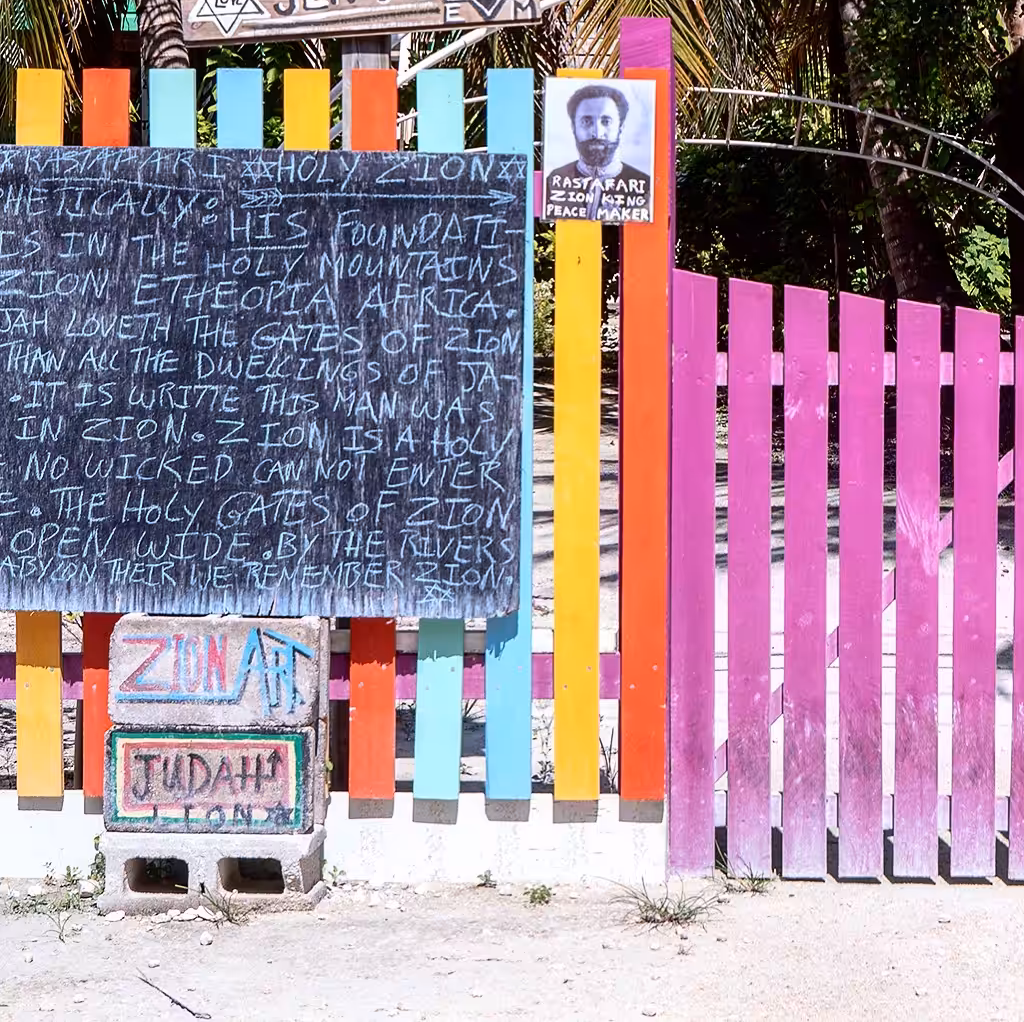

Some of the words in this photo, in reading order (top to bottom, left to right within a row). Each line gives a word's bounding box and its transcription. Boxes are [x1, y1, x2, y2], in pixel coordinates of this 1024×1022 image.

[278, 153, 361, 191] HOLY
[376, 154, 494, 183] ZION
[552, 175, 646, 194] RASTAFARI
[547, 204, 587, 217] PEACE
[597, 208, 649, 220] MAKER
[550, 190, 594, 203] ZION
[601, 193, 646, 206] KING
[230, 209, 307, 243] HIS
[58, 231, 107, 258] IN
[131, 234, 190, 269] THE
[206, 250, 304, 287] HOLY
[66, 310, 172, 344] LOVETH
[185, 314, 238, 347] THE
[252, 322, 364, 354] GATES
[381, 324, 433, 354] OF
[444, 326, 521, 355] ZION
[0, 340, 66, 375] THAN
[79, 346, 121, 371] ALL
[130, 344, 179, 373] THE
[398, 360, 444, 387] OF
[75, 382, 116, 407] IS
[255, 384, 319, 416] THIS
[333, 389, 399, 423] MAN
[411, 396, 495, 424] WAS
[15, 415, 64, 442] IN
[215, 418, 328, 451] ZION
[344, 426, 383, 453] IS
[395, 425, 420, 453] A
[24, 451, 70, 481] NO
[84, 451, 234, 485] WICKED
[253, 459, 304, 484] CAN
[315, 456, 366, 482] NOT
[387, 458, 505, 491] ENTER
[50, 487, 111, 523] THE
[122, 489, 204, 531] HOLY
[217, 490, 330, 529] GATES
[346, 491, 399, 523] OF
[406, 495, 516, 529] ZION
[10, 522, 116, 559] OPEN
[329, 529, 386, 558] THE
[400, 529, 515, 564] RIVERS
[103, 558, 176, 586] THEIR
[242, 561, 404, 590] REMEMBER
[118, 633, 228, 693] ZION
[235, 627, 316, 716] ART
[131, 753, 263, 801] JUDAH
